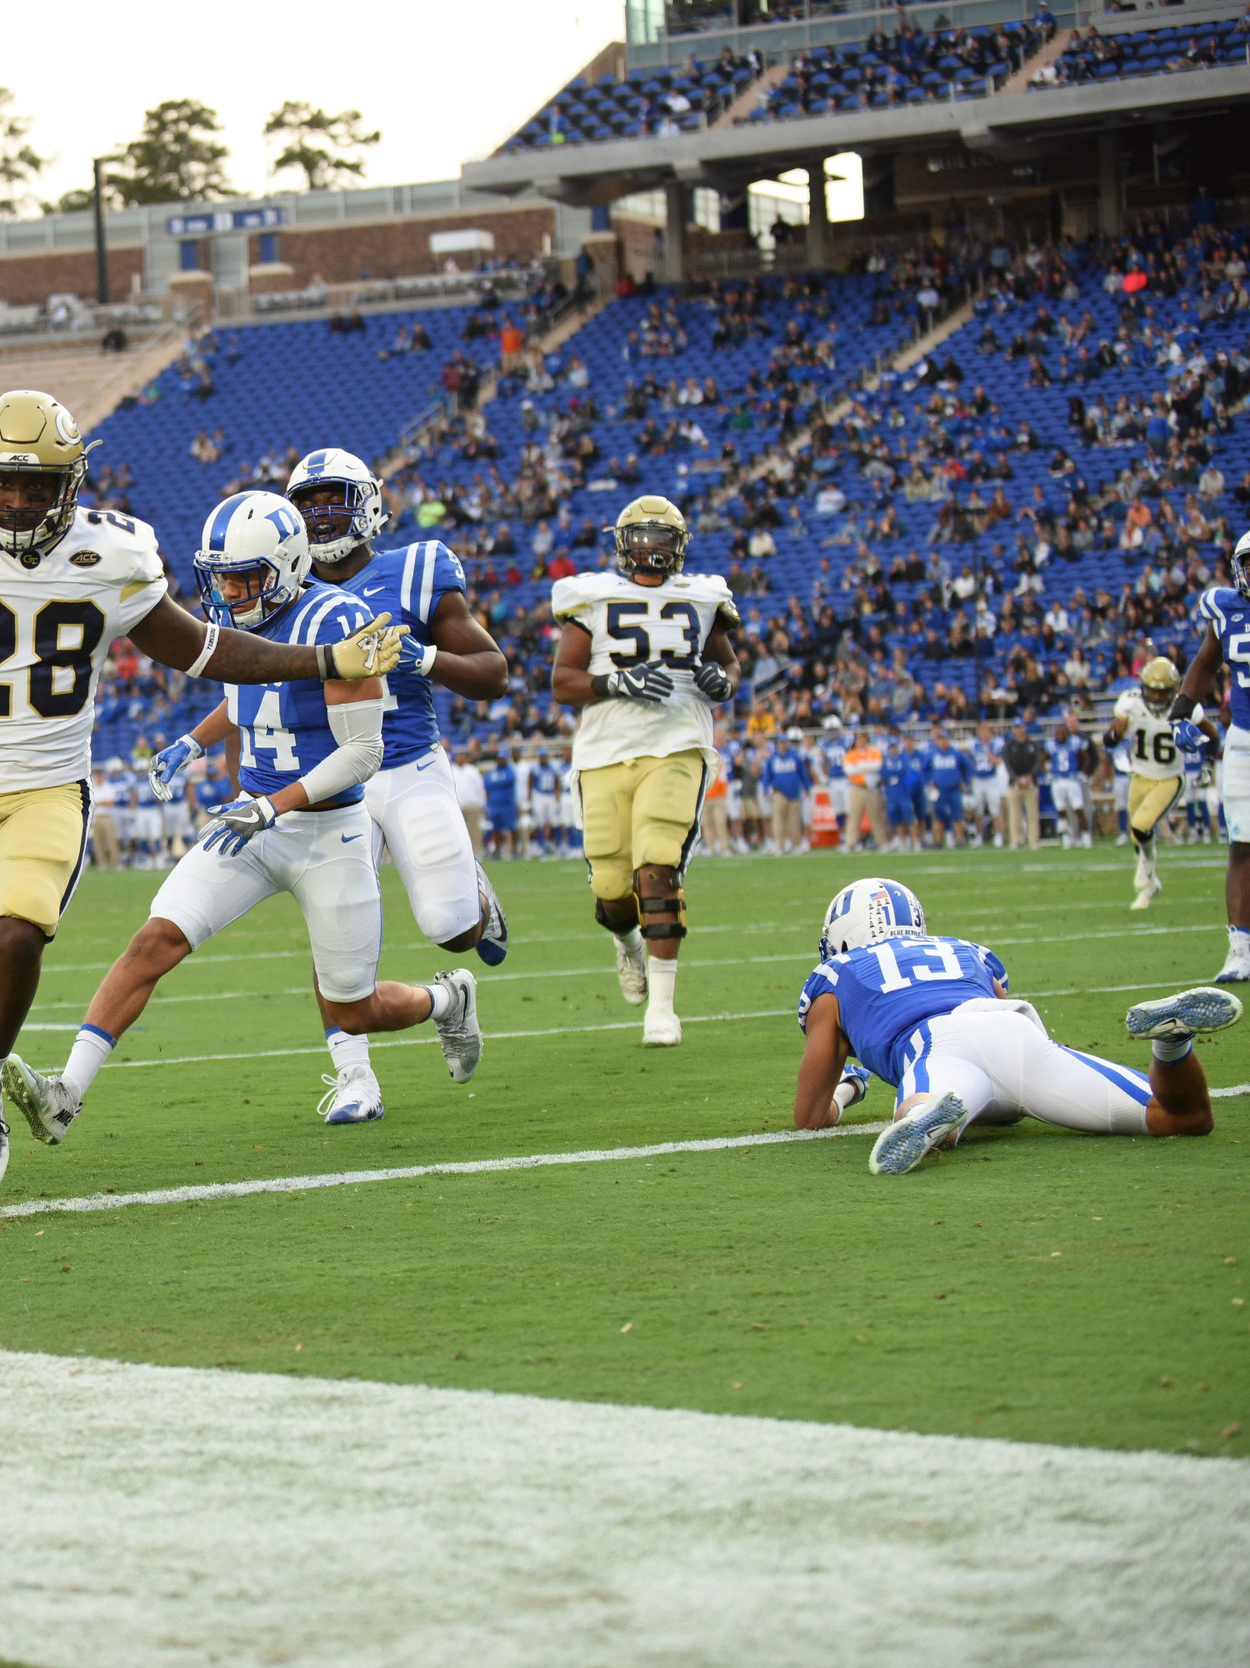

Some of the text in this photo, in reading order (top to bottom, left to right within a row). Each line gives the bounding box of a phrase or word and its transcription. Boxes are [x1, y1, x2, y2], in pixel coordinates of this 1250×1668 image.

[8, 454, 29, 462] ACC
[73, 553, 98, 562] ACC
[605, 599, 701, 671] 53
[223, 682, 300, 772] 14
[1135, 728, 1177, 765] 16
[890, 929, 904, 937] BLUE
[866, 940, 965, 994] 13
